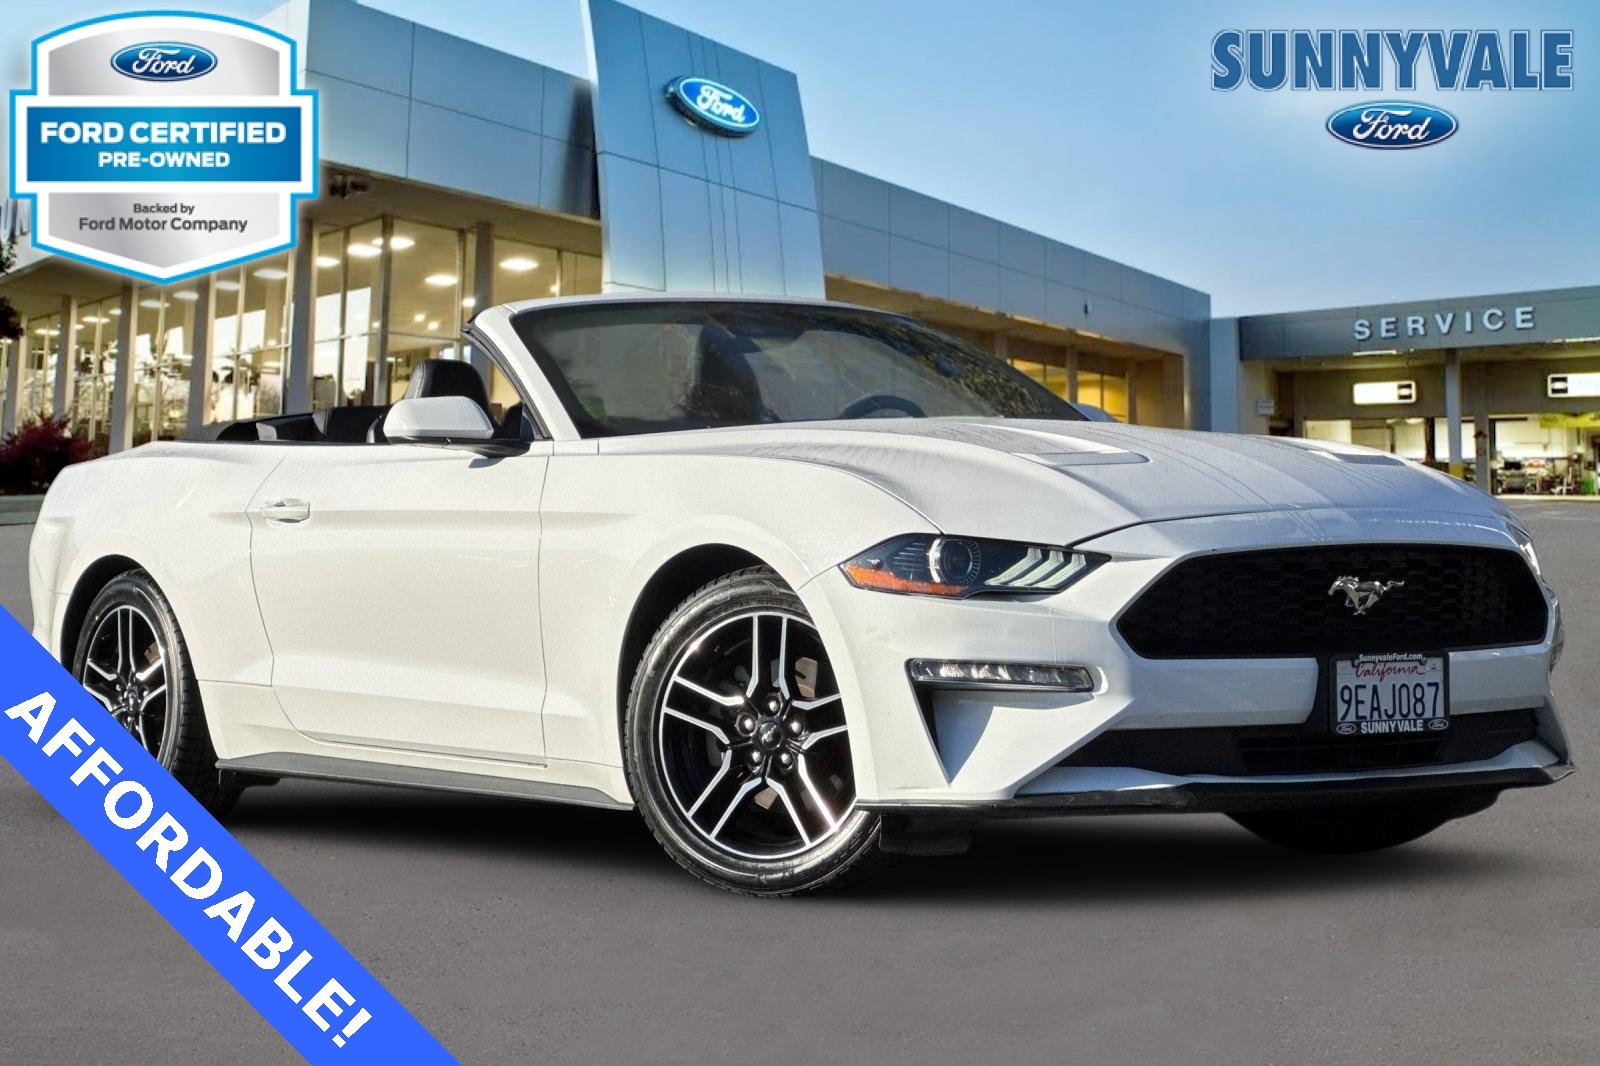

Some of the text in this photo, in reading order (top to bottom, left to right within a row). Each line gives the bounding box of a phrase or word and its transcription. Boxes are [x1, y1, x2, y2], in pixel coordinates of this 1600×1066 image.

[696, 85, 745, 122] Ford
[1352, 306, 1536, 341] SERVICE
[1358, 652, 1423, 662] SunnyvaleFord.com
[1355, 661, 1426, 682] California
[1340, 682, 1440, 720] 9EAJ087
[1360, 720, 1424, 734] SUNNYVALE
